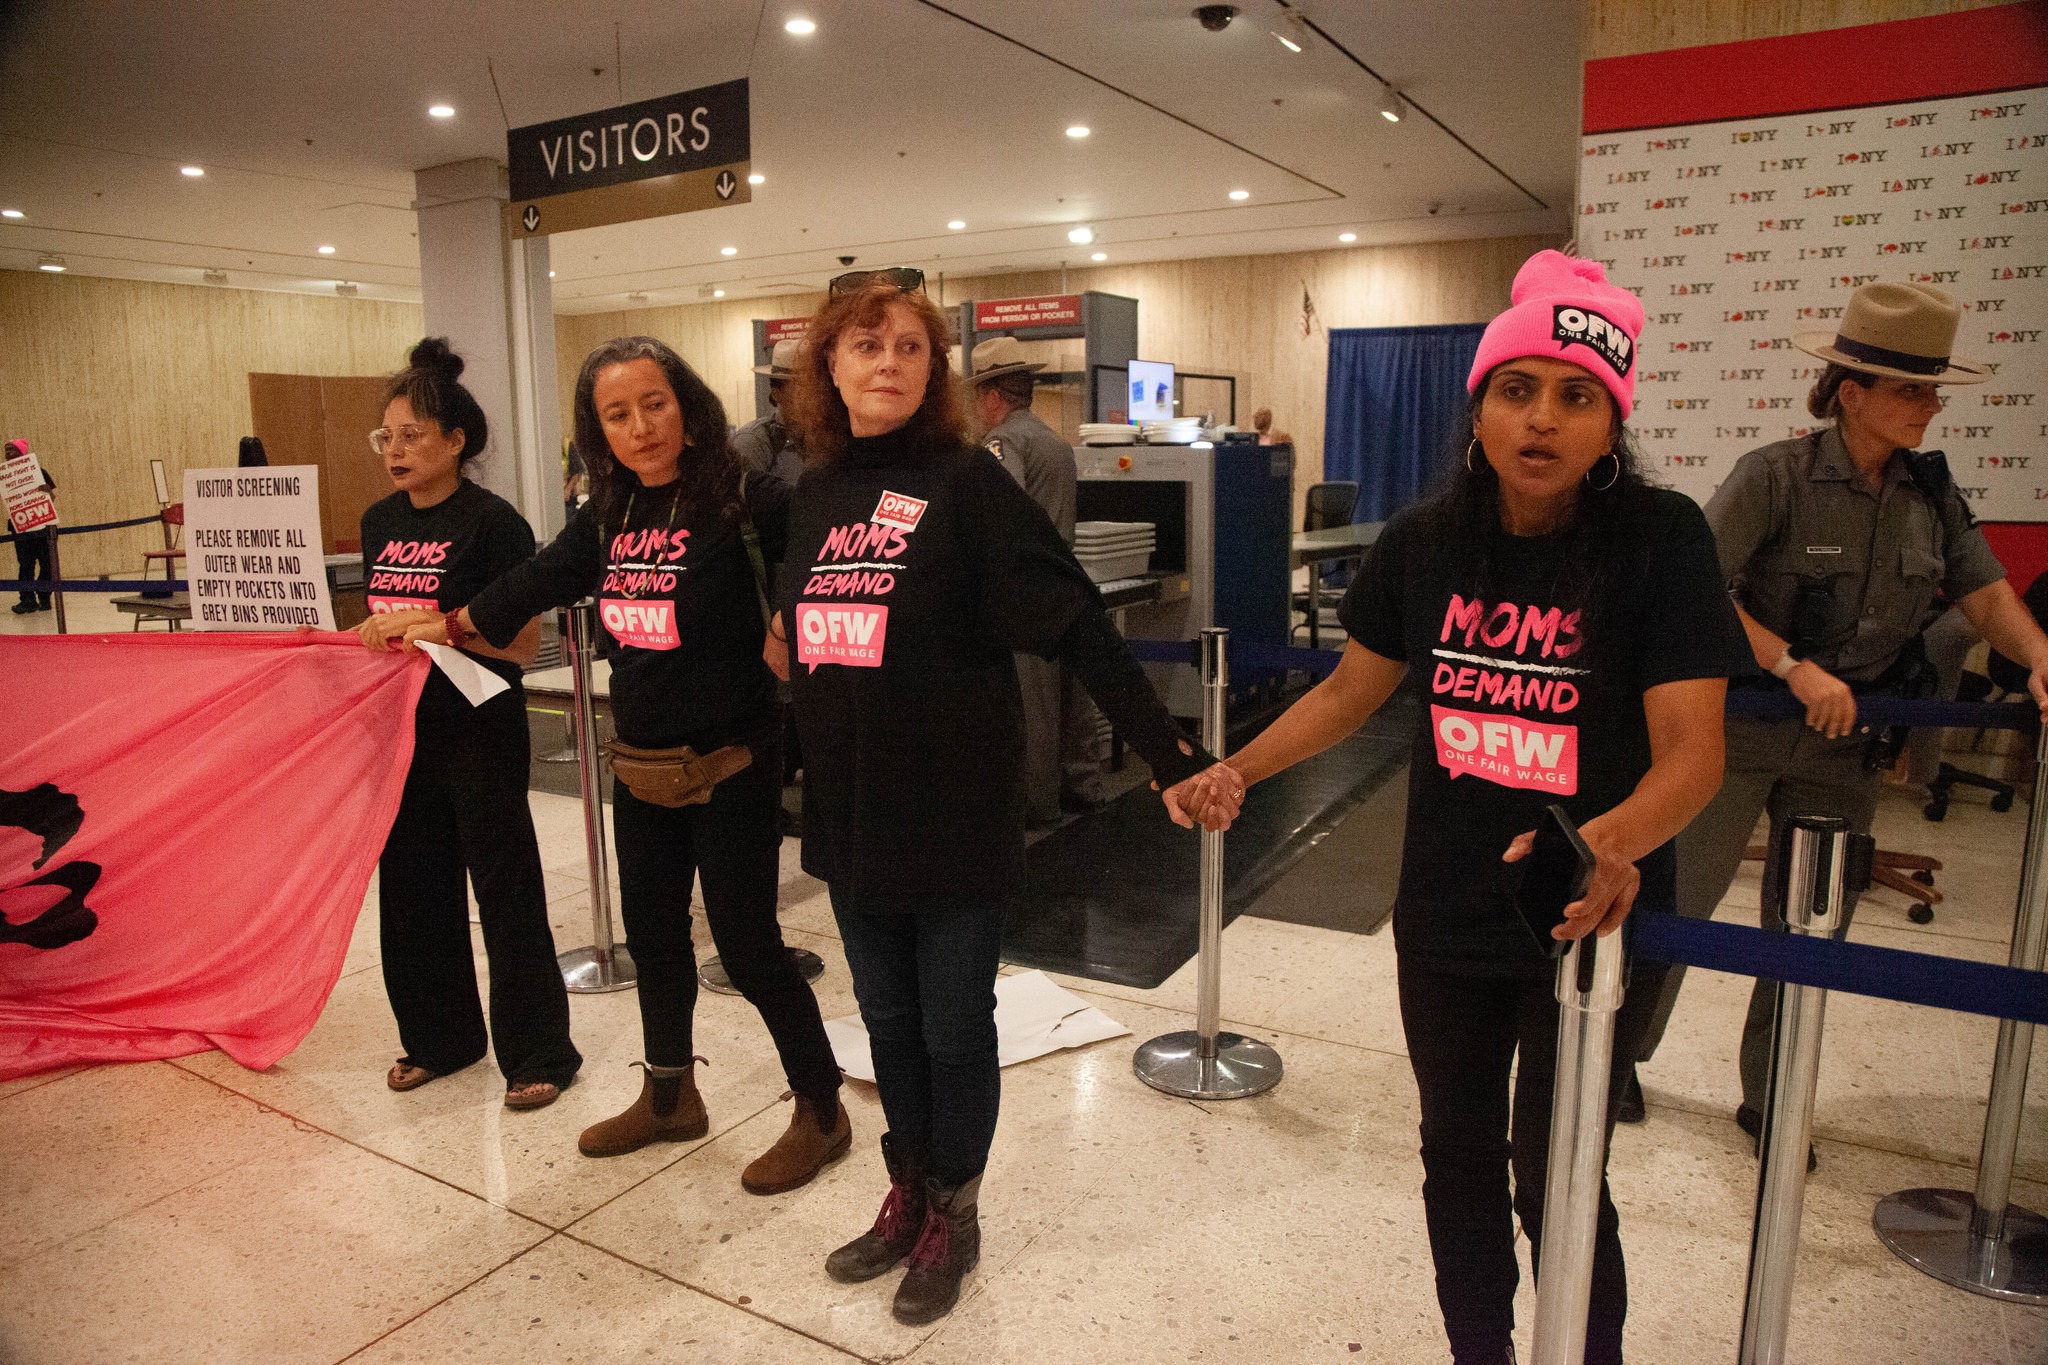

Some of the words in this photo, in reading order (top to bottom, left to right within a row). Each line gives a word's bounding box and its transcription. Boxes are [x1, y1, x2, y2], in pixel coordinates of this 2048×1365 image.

[1994, 103, 2026, 118] NY
[1908, 113, 1938, 126] NY
[1829, 121, 1856, 135] NY
[540, 106, 710, 178] VISITORS
[1753, 129, 1778, 142] NY
[1598, 144, 1620, 156] NY
[1667, 138, 1690, 150] NY
[1944, 142, 1974, 156] NY
[1860, 150, 1887, 163] NY
[1782, 158, 1807, 170] NY
[1627, 171, 1650, 183] NY
[1698, 165, 1721, 177] NY
[1990, 170, 2020, 184] NY
[1906, 177, 1934, 190] NY
[1751, 190, 1776, 202] NY
[1826, 184, 1853, 197] NY
[1596, 202, 1619, 214] NY
[1665, 196, 1689, 209] NY
[1938, 206, 1967, 219] NY
[1779, 218, 1805, 231] NY
[1856, 213, 1882, 226] NY
[1624, 228, 1647, 240] NY
[1695, 223, 1718, 235] NY
[1900, 241, 1927, 254] NY
[1984, 235, 2014, 248] NY
[1746, 251, 1771, 262] NY
[1821, 246, 1847, 259] NY
[1663, 255, 1686, 267] NY
[1932, 271, 1960, 283] NY
[2016, 265, 2047, 278] NY
[1690, 283, 1714, 294] NY
[1775, 279, 1799, 291] NY
[1024, 303, 1036, 311] ALL
[1977, 299, 2005, 312] NY
[1659, 313, 1682, 324] NY
[1745, 310, 1769, 321] NY
[1818, 307, 1844, 318] NY
[1559, 309, 1631, 359] OFW
[2012, 330, 2042, 343] NY
[1559, 329, 1581, 338] ONE
[1586, 336, 1605, 351] FAIR
[1607, 349, 1627, 371] WAGE
[1689, 341, 1713, 352] NY
[1658, 371, 1680, 382] NY
[1741, 369, 1765, 380] NY
[1687, 399, 1709, 409] NY
[1769, 398, 1793, 409] NY
[2006, 394, 2035, 406] NY
[1654, 428, 1676, 439] NY
[1736, 427, 1760, 438] NY
[1965, 426, 1993, 438] NY
[1685, 456, 1708, 466] NY
[2002, 457, 2030, 468] NY
[197, 479, 233, 497] VISITOR
[237, 477, 300, 497] SCREENING
[884, 497, 922, 516] OFW
[15, 503, 49, 524] OFW
[196, 530, 232, 547] PLEASE
[237, 530, 281, 547] REMOVE
[287, 529, 306, 547] ALL
[611, 528, 691, 561] MOMS
[817, 522, 908, 561] MOMS
[376, 541, 452, 565] MOMS
[205, 555, 237, 573] OUTER
[241, 556, 273, 574] WEAR
[278, 556, 300, 574] AND
[369, 572, 439, 593] DEMAND
[603, 571, 677, 596] DEMAND
[803, 571, 895, 597] DEMAND
[198, 579, 231, 597] EMPTY
[236, 581, 286, 599] POCKETS
[289, 582, 316, 600] INTO
[202, 604, 227, 622] GREY
[232, 605, 259, 623] BINS
[262, 606, 319, 625] PROVIDED
[604, 604, 668, 633] OFW
[802, 609, 879, 645] OFW
[1440, 594, 1584, 659] MOMS
[648, 635, 674, 643] WAGE
[805, 646, 826, 655] ONE
[830, 647, 846, 656] FAIR
[849, 648, 875, 658] WAGE
[1432, 662, 1579, 713] DEMAND
[1439, 716, 1566, 769] OFW
[1445, 750, 1475, 765] ONE
[1481, 758, 1510, 776] FAIR
[1517, 769, 1567, 784] WAGE
